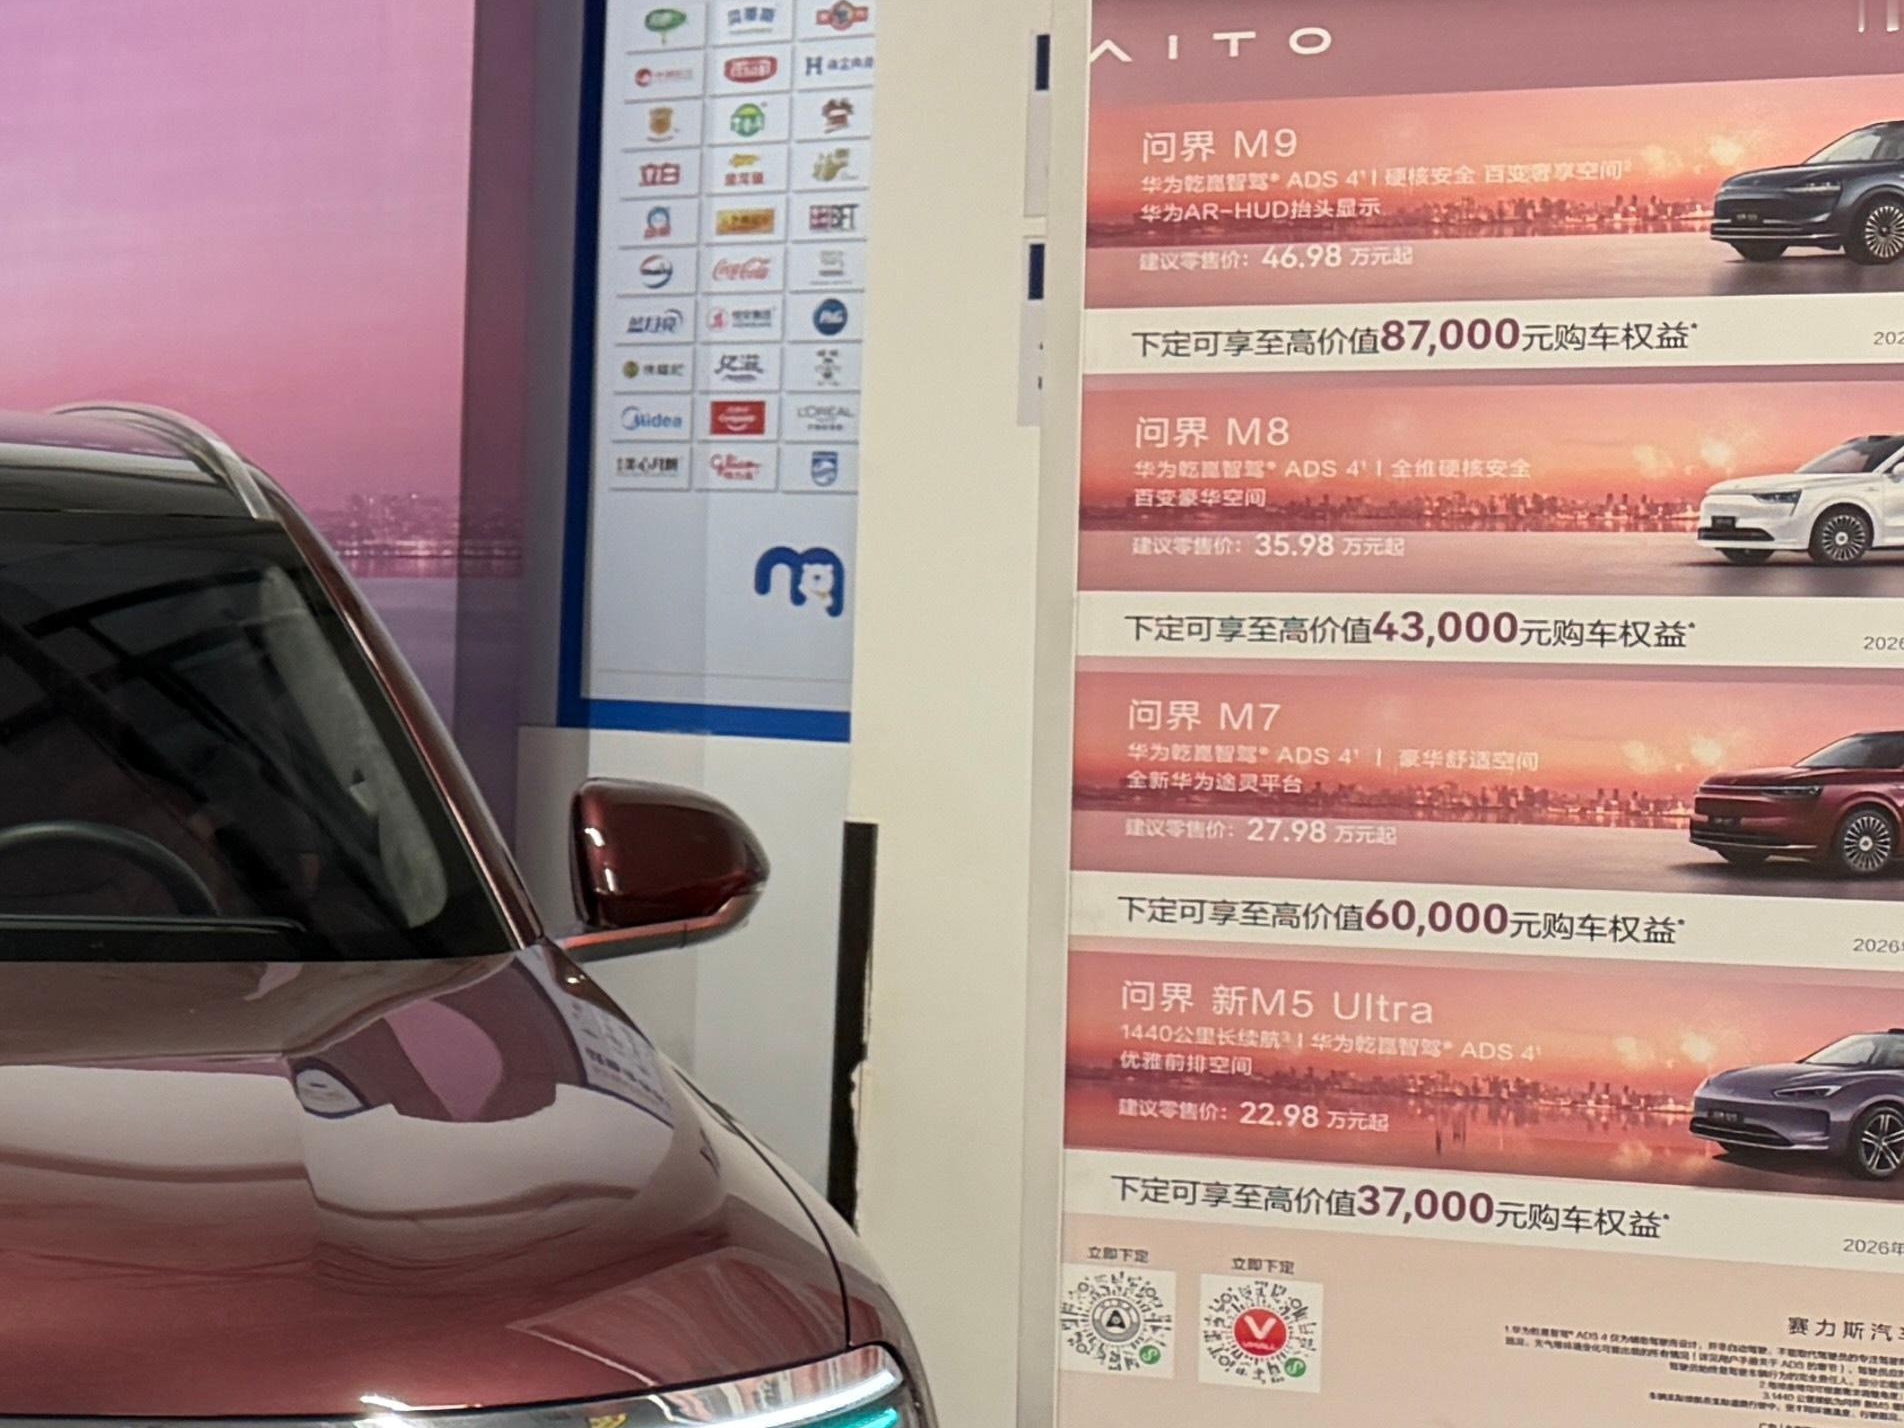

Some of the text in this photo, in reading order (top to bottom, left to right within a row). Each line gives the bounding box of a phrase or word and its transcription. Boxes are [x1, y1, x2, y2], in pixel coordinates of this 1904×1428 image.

[1090, 26, 1333, 62] AITO
[1142, 128, 1298, 164] 问界 M9
[1287, 170, 1338, 190] ADS
[1140, 197, 1381, 223] 华为AR-HUD抬头显示
[1262, 243, 1343, 269] 46.98
[1350, 245, 1414, 267] 万元起
[1135, 416, 1290, 448] 问界 M8
[1285, 459, 1337, 478] ADS
[1134, 488, 1266, 508] 百变豪华空间
[1254, 533, 1335, 557] 35.98
[1341, 536, 1405, 558] 万元起
[1128, 699, 1282, 732] 问界 M7
[1276, 747, 1329, 766] ADS
[1397, 748, 1538, 772] 豪华舒适空间
[1127, 772, 1303, 794] 全新华为途灵平台
[1246, 817, 1327, 843] 27.98
[1334, 823, 1397, 845] 万元起
[1853, 938, 1904, 954] 2026
[1121, 980, 1434, 1025] 问界 新M5 Ultra
[1120, 1051, 1253, 1076] 优雅前排空间
[1461, 1041, 1514, 1062] ADS
[1239, 1100, 1319, 1130] 22.98
[1326, 1109, 1390, 1133] 万元起
[1087, 1246, 1149, 1263] 立即下定
[1232, 1257, 1296, 1275] 立即下定
